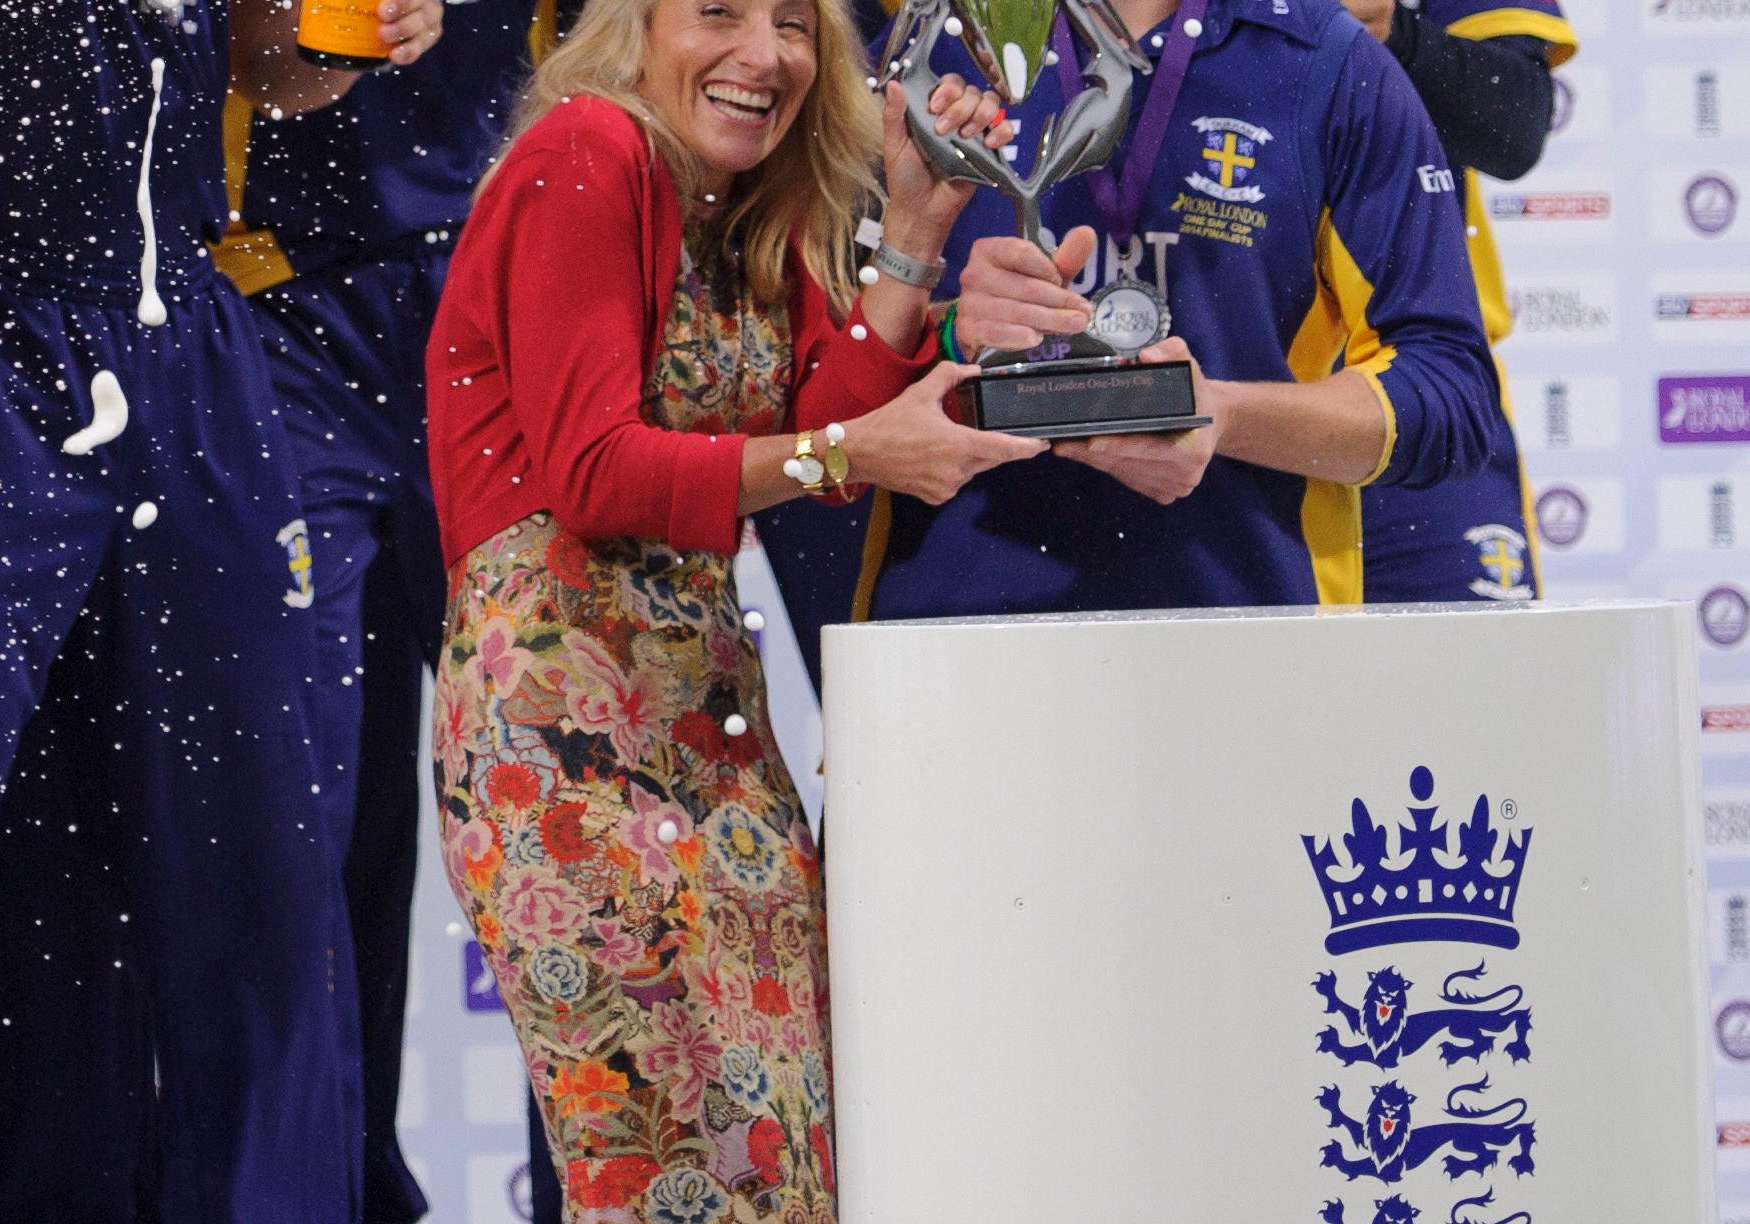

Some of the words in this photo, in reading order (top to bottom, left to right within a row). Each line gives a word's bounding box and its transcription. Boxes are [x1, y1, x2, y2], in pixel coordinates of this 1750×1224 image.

[1183, 196, 1220, 217] ROYAL
[1219, 202, 1268, 229] LONDON
[1027, 342, 1071, 361] CUP
[1017, 381, 1046, 396] Royal
[1049, 379, 1085, 393] London
[1087, 377, 1130, 391] One-Day
[1133, 375, 1155, 389] Cup
